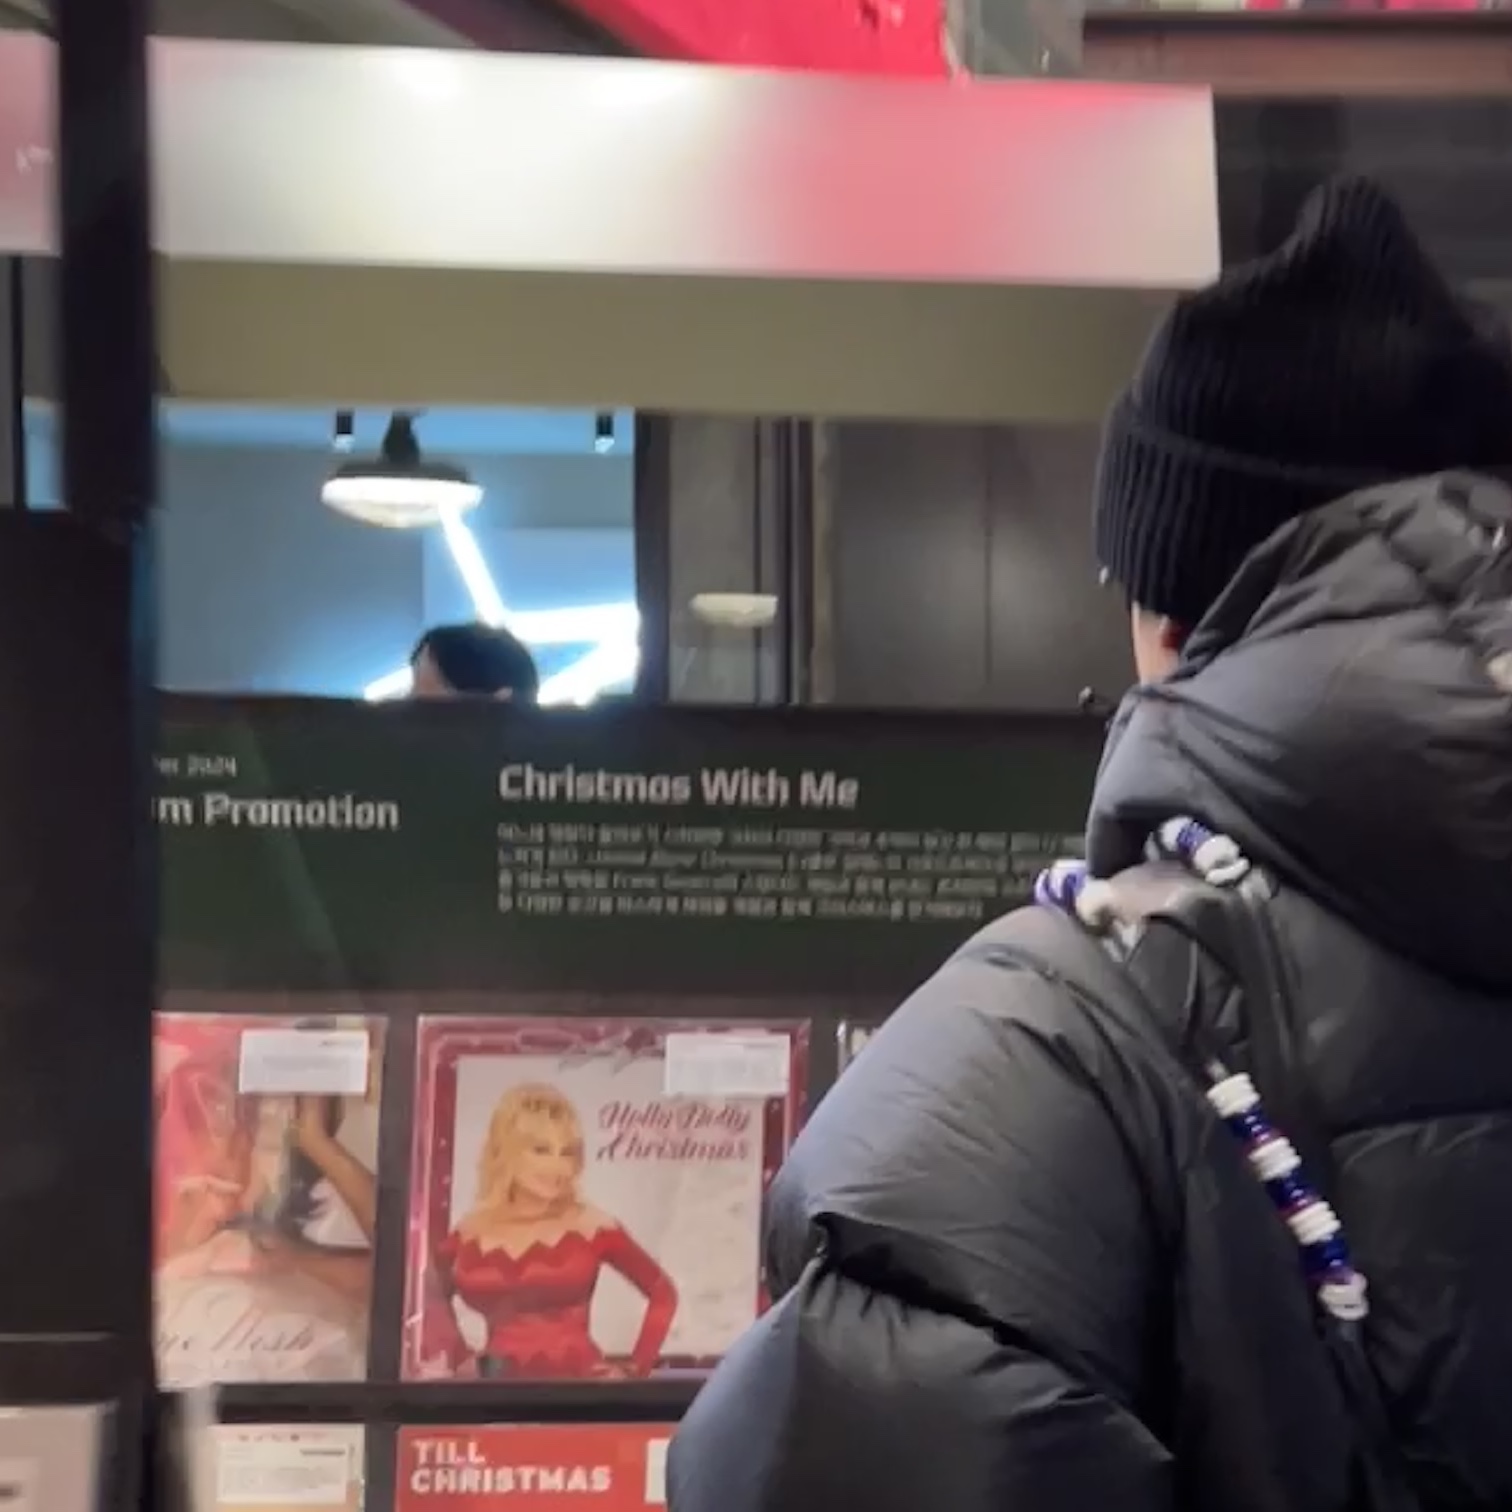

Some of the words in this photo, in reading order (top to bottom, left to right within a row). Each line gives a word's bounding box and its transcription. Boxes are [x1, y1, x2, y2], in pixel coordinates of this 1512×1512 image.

[499, 763, 691, 804] Christmas
[701, 768, 789, 807] With
[800, 771, 859, 808] Me
[204, 792, 400, 830] Promotion
[599, 1100, 673, 1130] Holly
[596, 1132, 748, 1164] Christmas
[411, 1440, 486, 1465] TILL
[411, 1465, 611, 1493] CHRISTMAS
